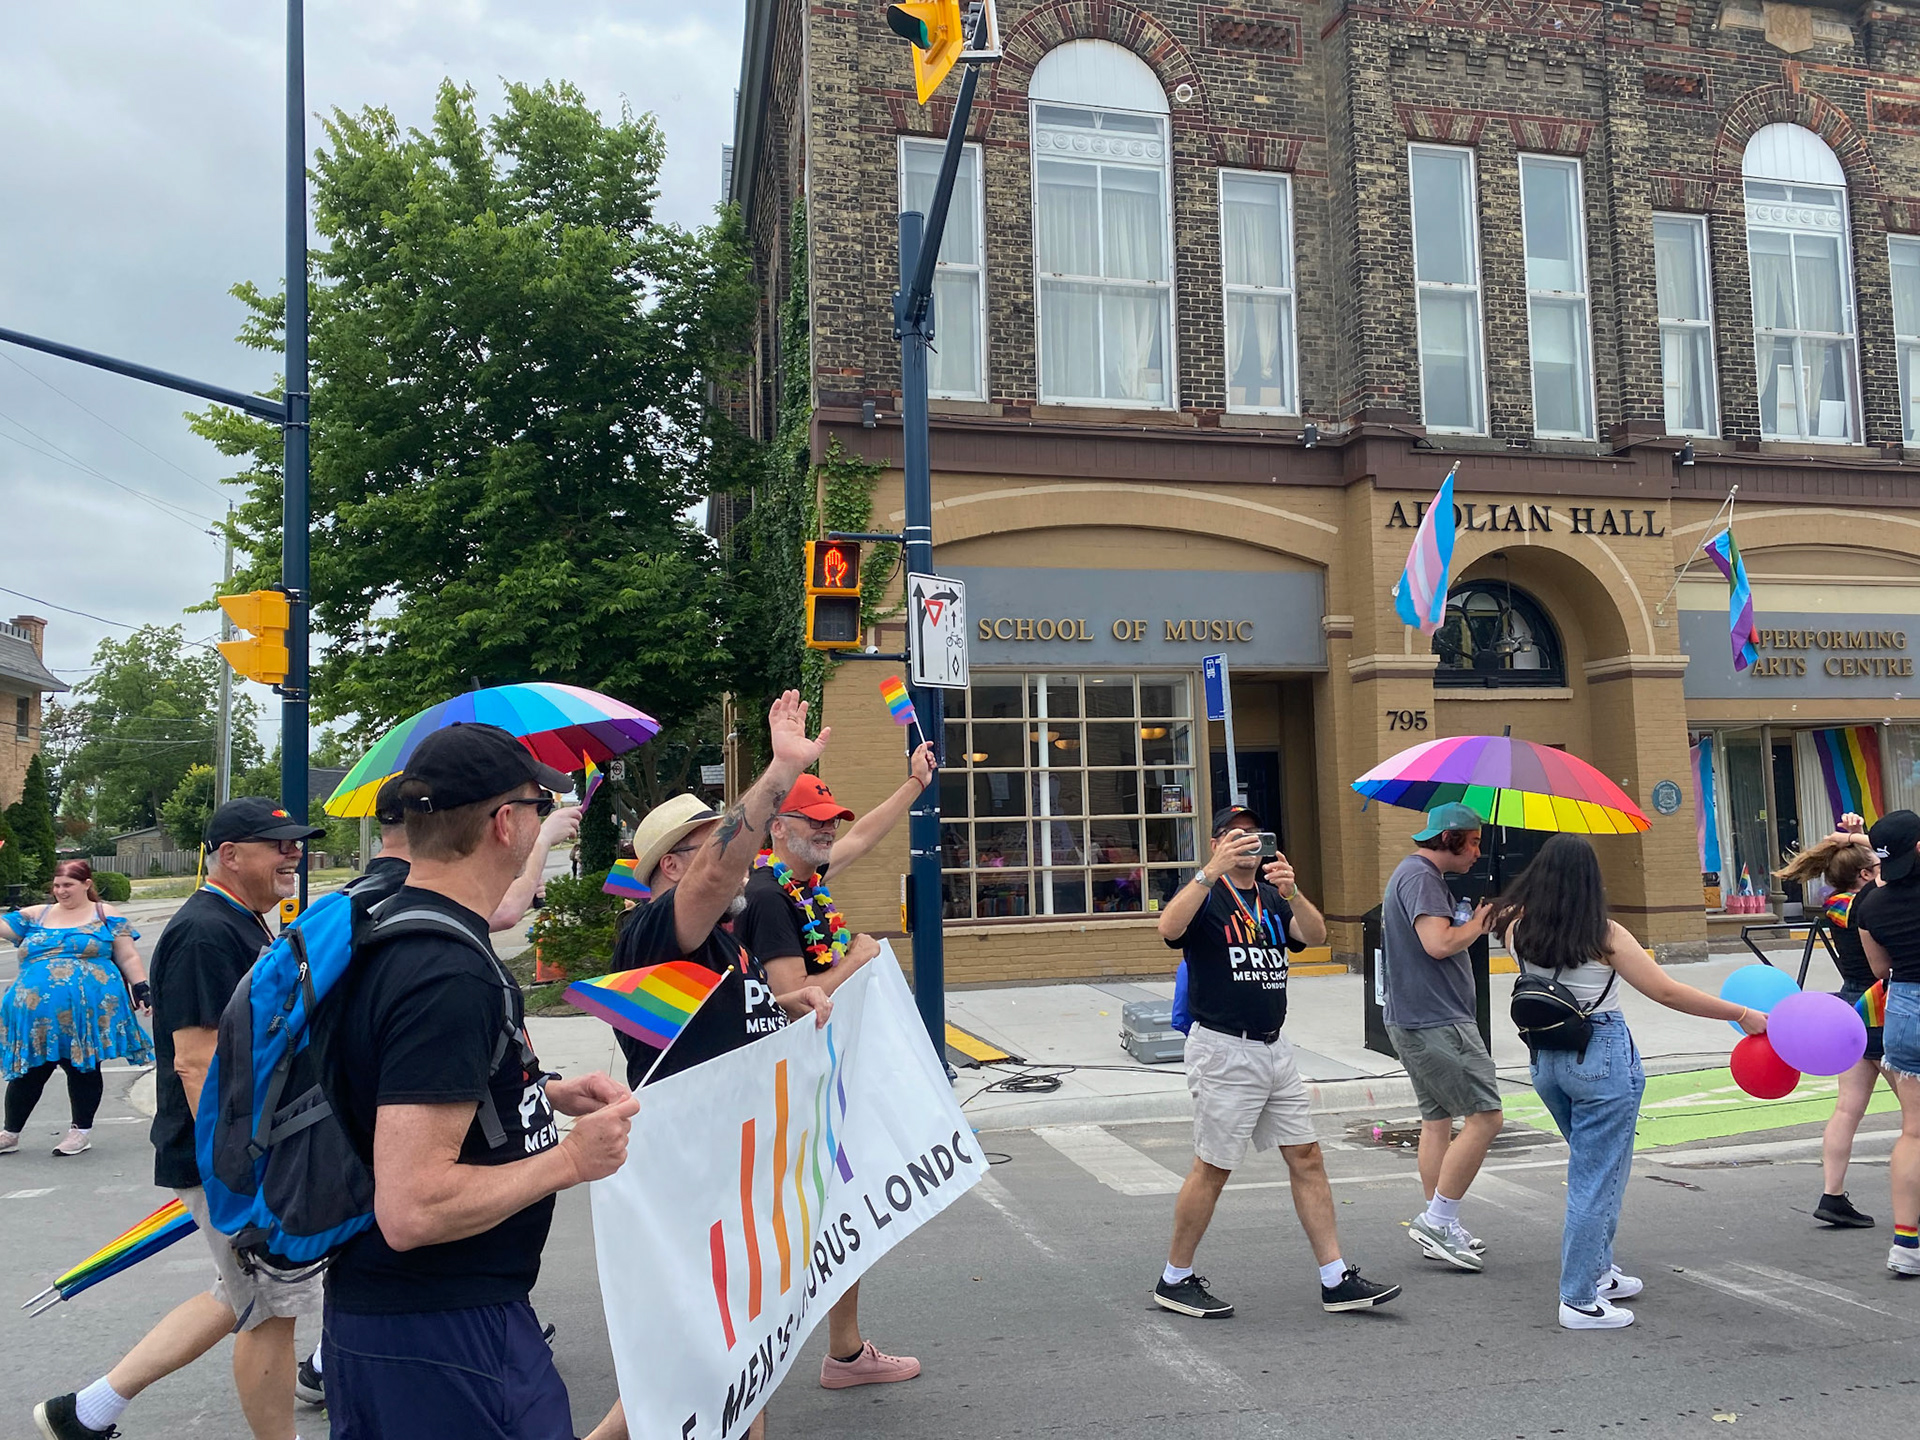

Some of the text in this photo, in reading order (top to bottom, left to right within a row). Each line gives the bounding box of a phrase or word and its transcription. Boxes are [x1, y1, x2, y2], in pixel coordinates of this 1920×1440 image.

[1569, 507, 1666, 538] HALL
[978, 617, 1255, 642] SCHOOL OF MUSIC
[1760, 628, 1907, 650] PERFORMING
[1752, 656, 1914, 677] ARTS CENTRE
[1386, 710, 1428, 731] 795
[1233, 970, 1268, 982] MEN'S
